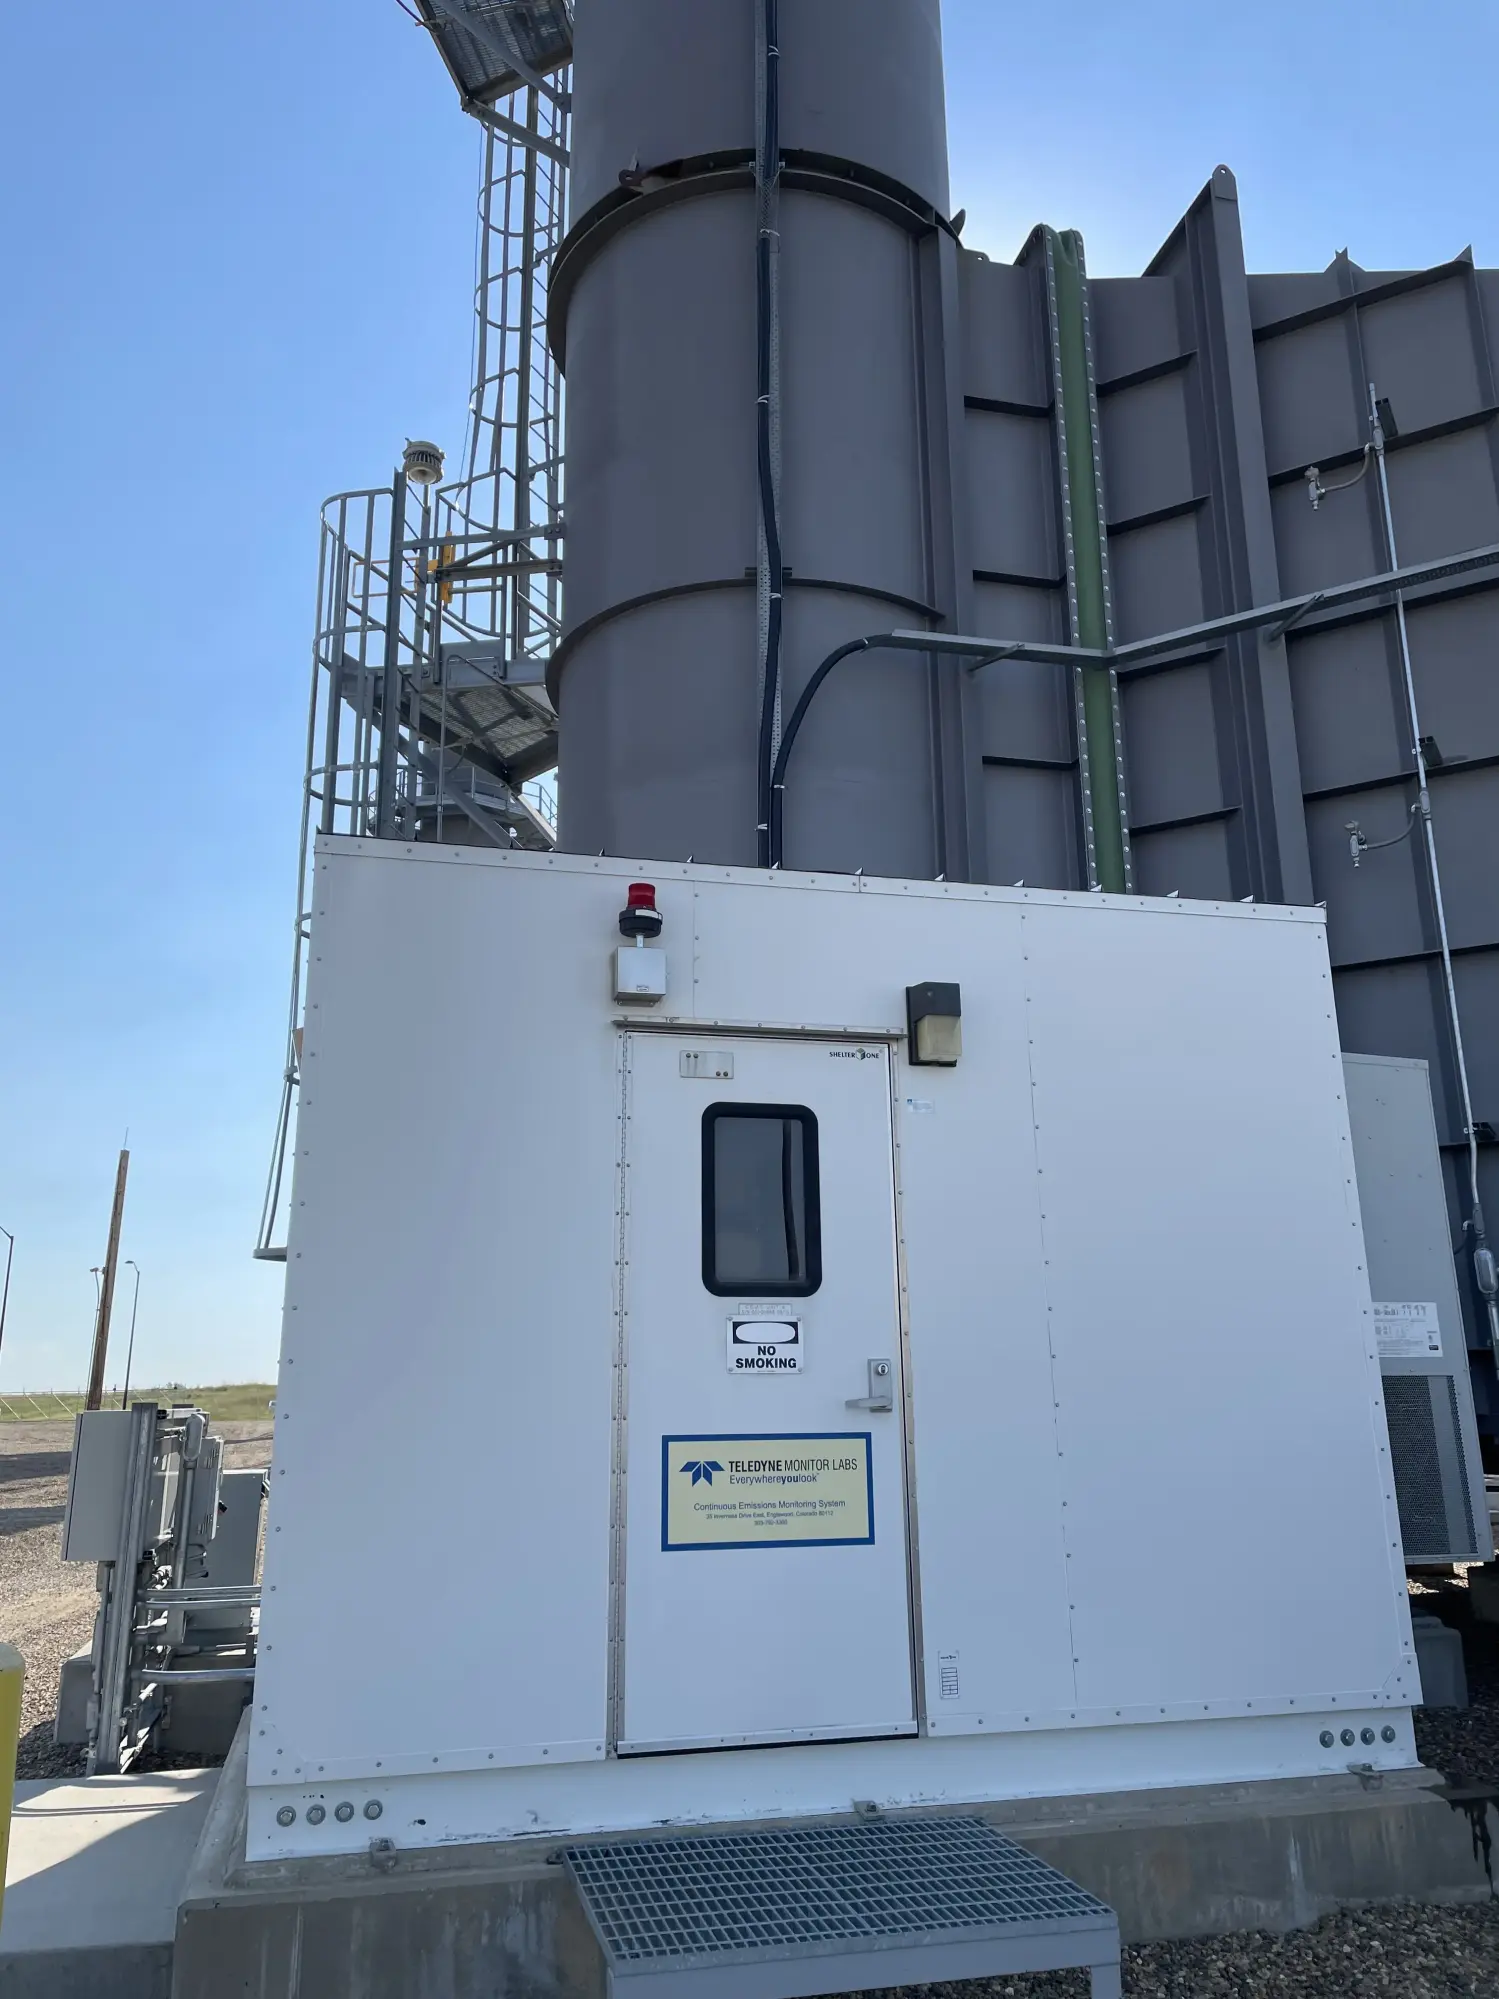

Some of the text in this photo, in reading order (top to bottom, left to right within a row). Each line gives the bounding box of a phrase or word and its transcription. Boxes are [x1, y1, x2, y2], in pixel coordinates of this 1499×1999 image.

[829, 1051, 856, 1059] SHELTER
[757, 1345, 776, 1356] NO
[735, 1357, 797, 1369] SMOKING
[729, 1458, 858, 1472] TELEDYNE MONITOR LABS
[693, 1499, 846, 1511] Continuous Emissions Monitoring System
